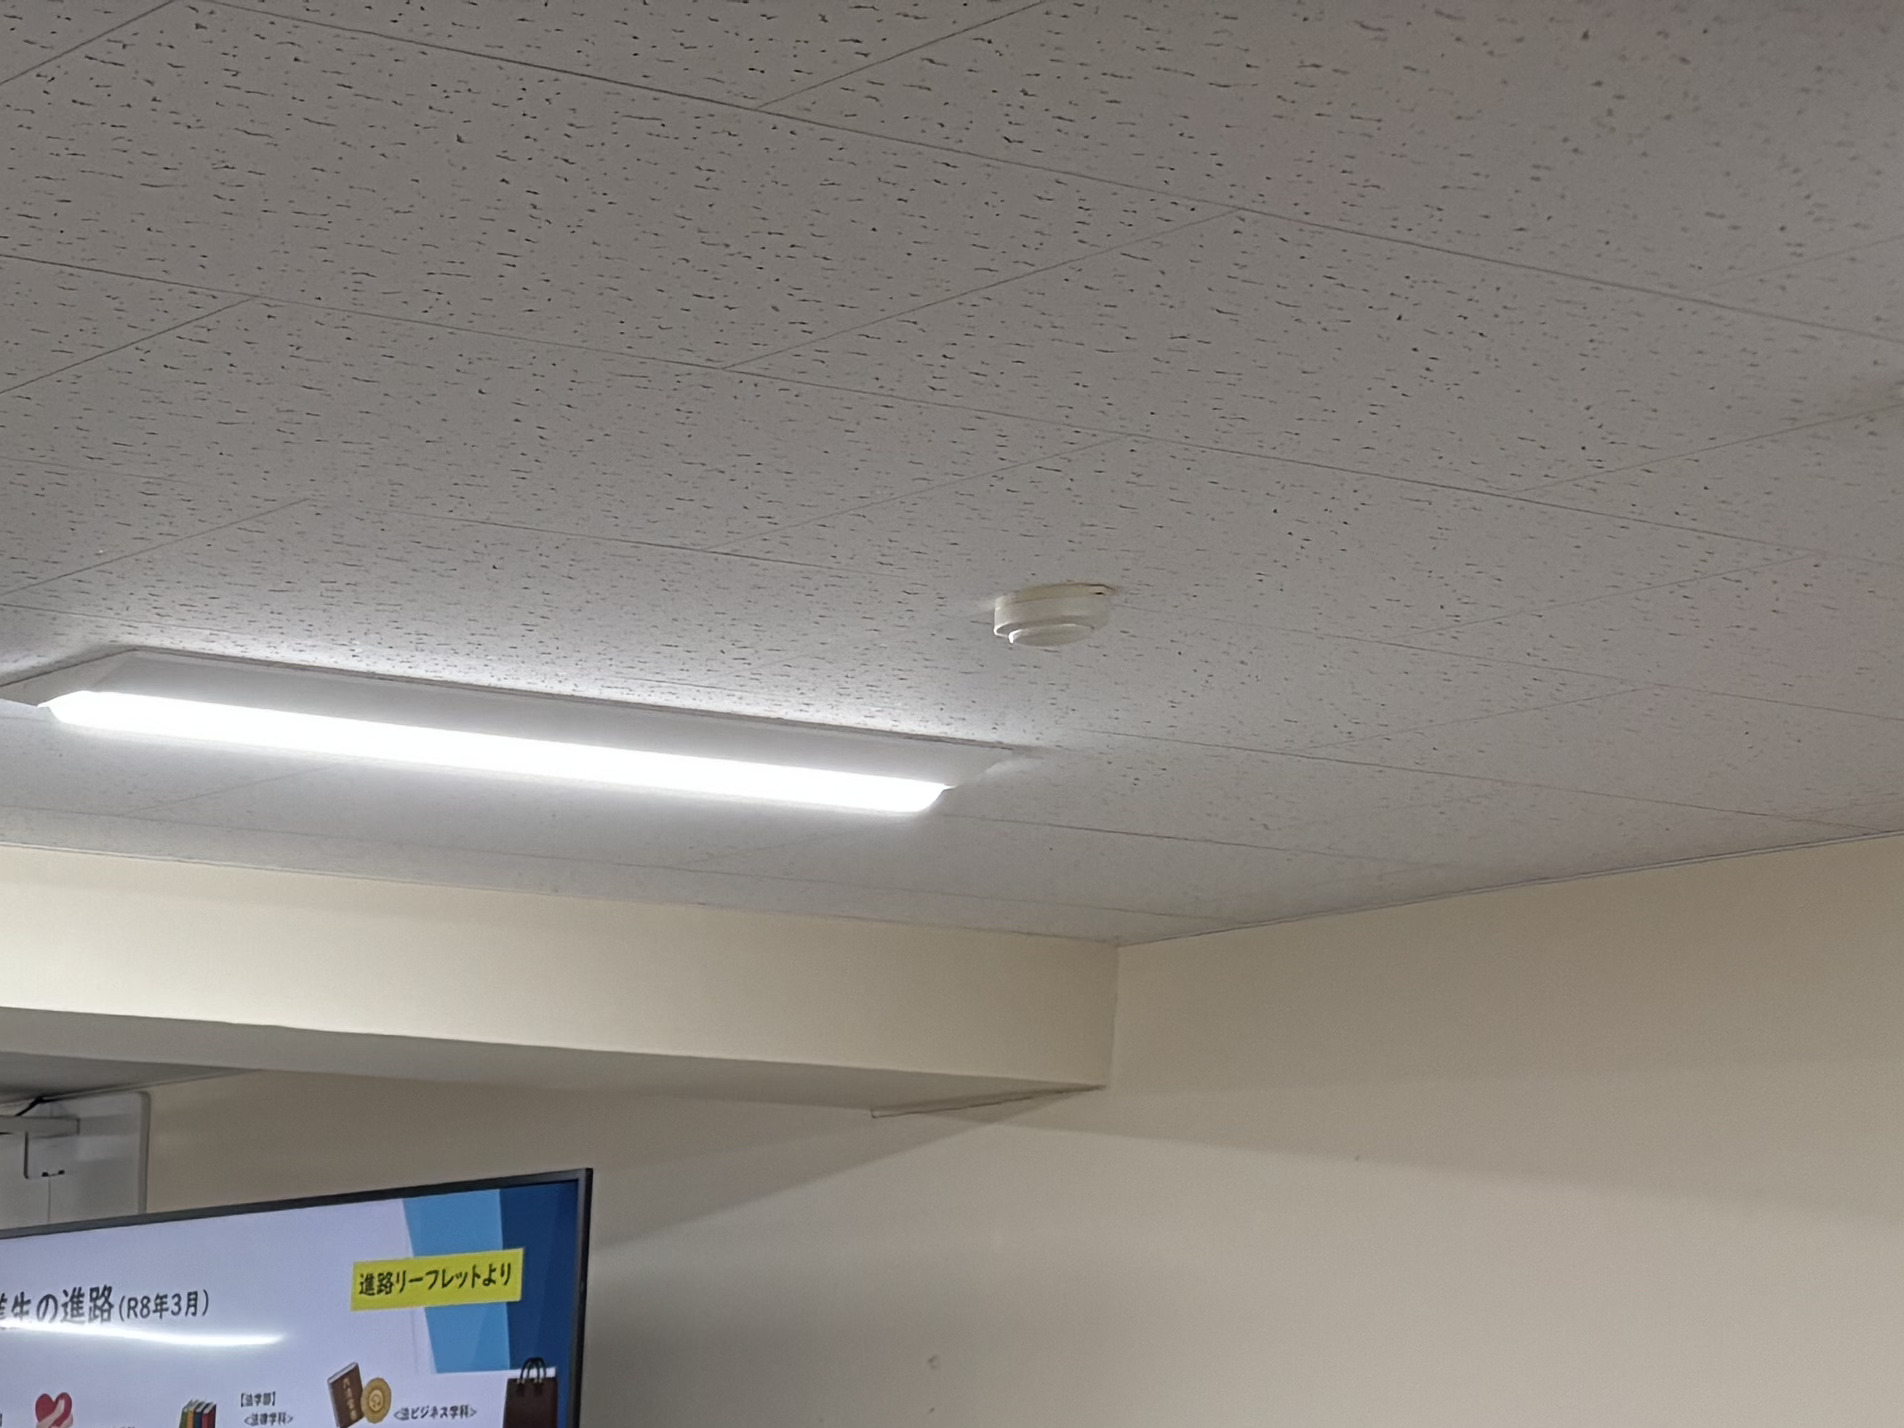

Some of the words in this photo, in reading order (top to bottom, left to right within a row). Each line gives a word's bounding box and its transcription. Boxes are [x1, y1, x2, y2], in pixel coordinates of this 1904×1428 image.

[359, 1262, 512, 1297] 進路リーフレットより
